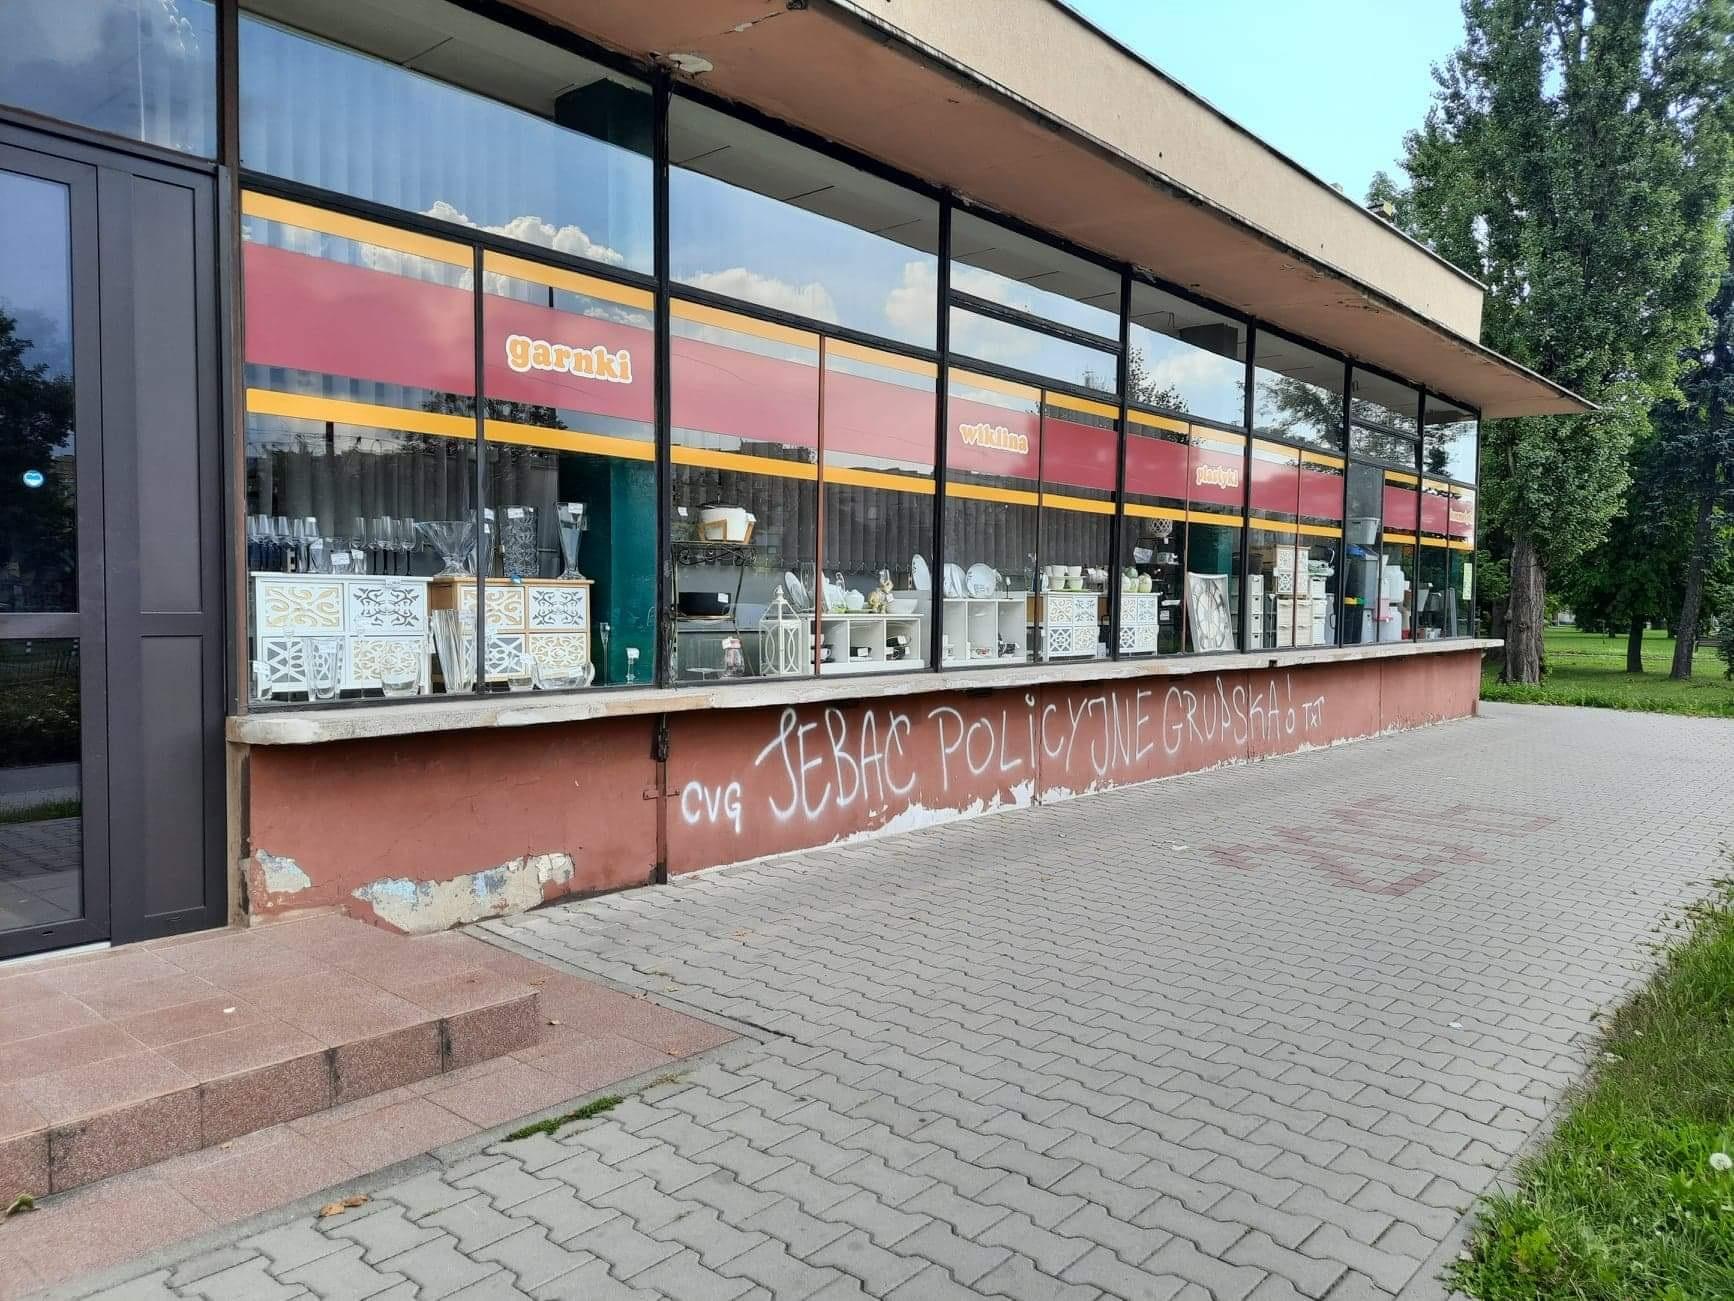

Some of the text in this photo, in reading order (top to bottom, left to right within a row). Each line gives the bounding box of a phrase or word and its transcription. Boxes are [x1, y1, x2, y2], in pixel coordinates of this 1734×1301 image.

[506, 335, 632, 384] garnki
[959, 423, 1028, 454] wiklina
[682, 781, 741, 833] CVG
